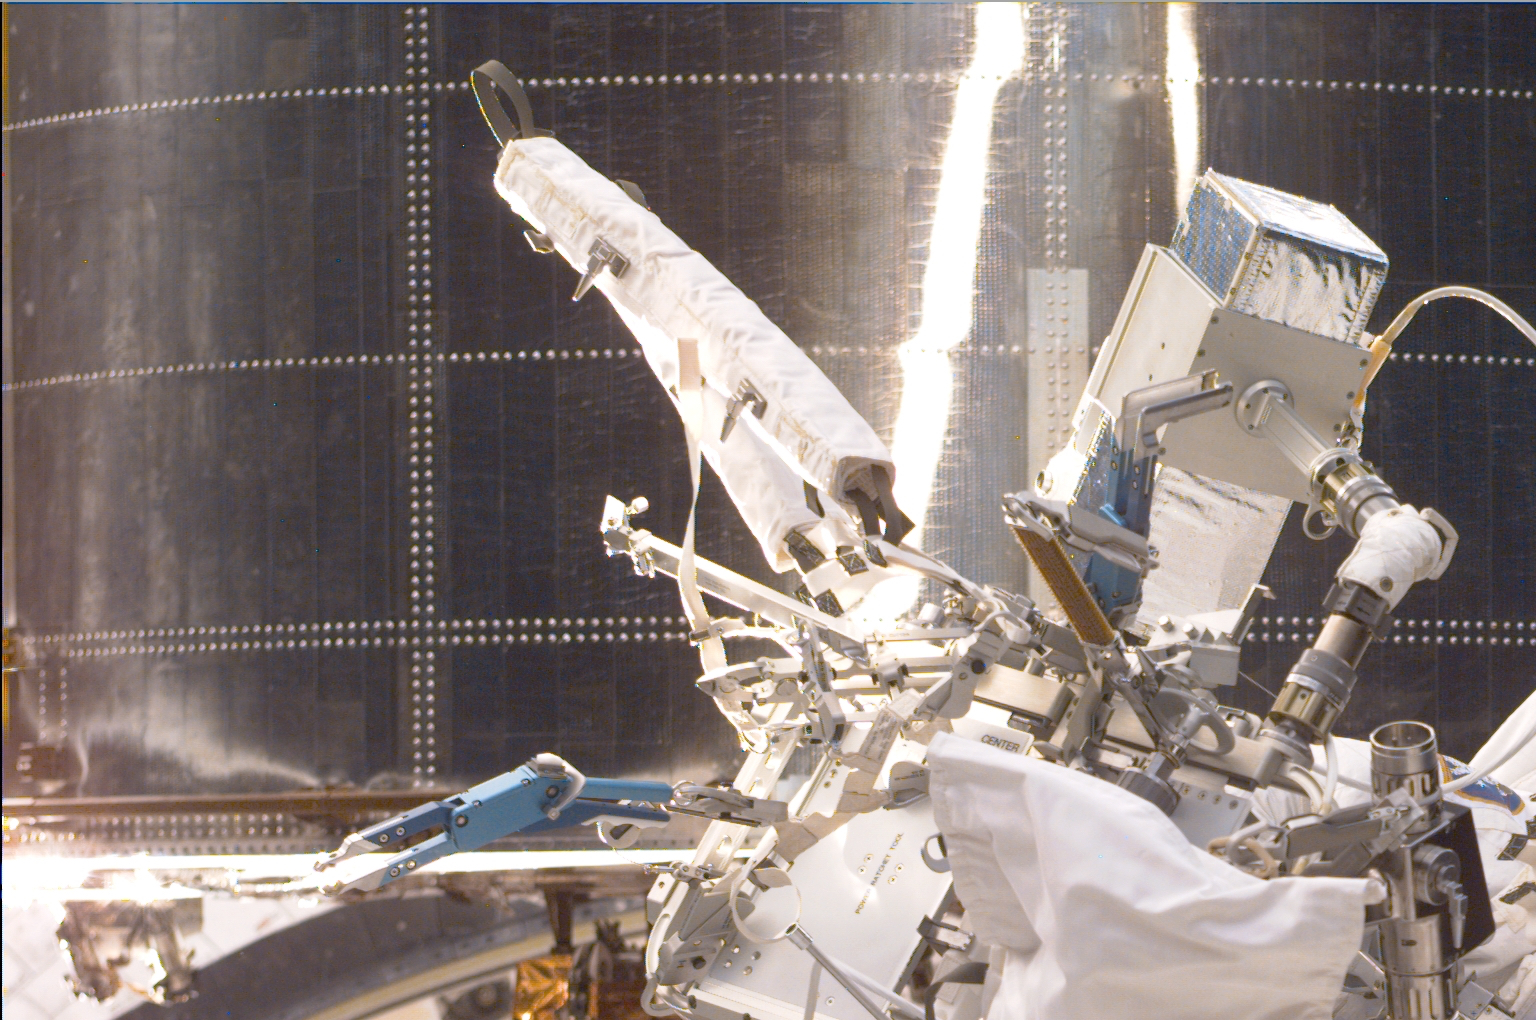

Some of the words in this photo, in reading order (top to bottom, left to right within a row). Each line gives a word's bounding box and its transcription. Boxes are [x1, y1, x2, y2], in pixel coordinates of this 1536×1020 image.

[981, 734, 1021, 753] CENTER
[854, 887, 872, 915] POWR
[889, 833, 905, 851] TOOL
